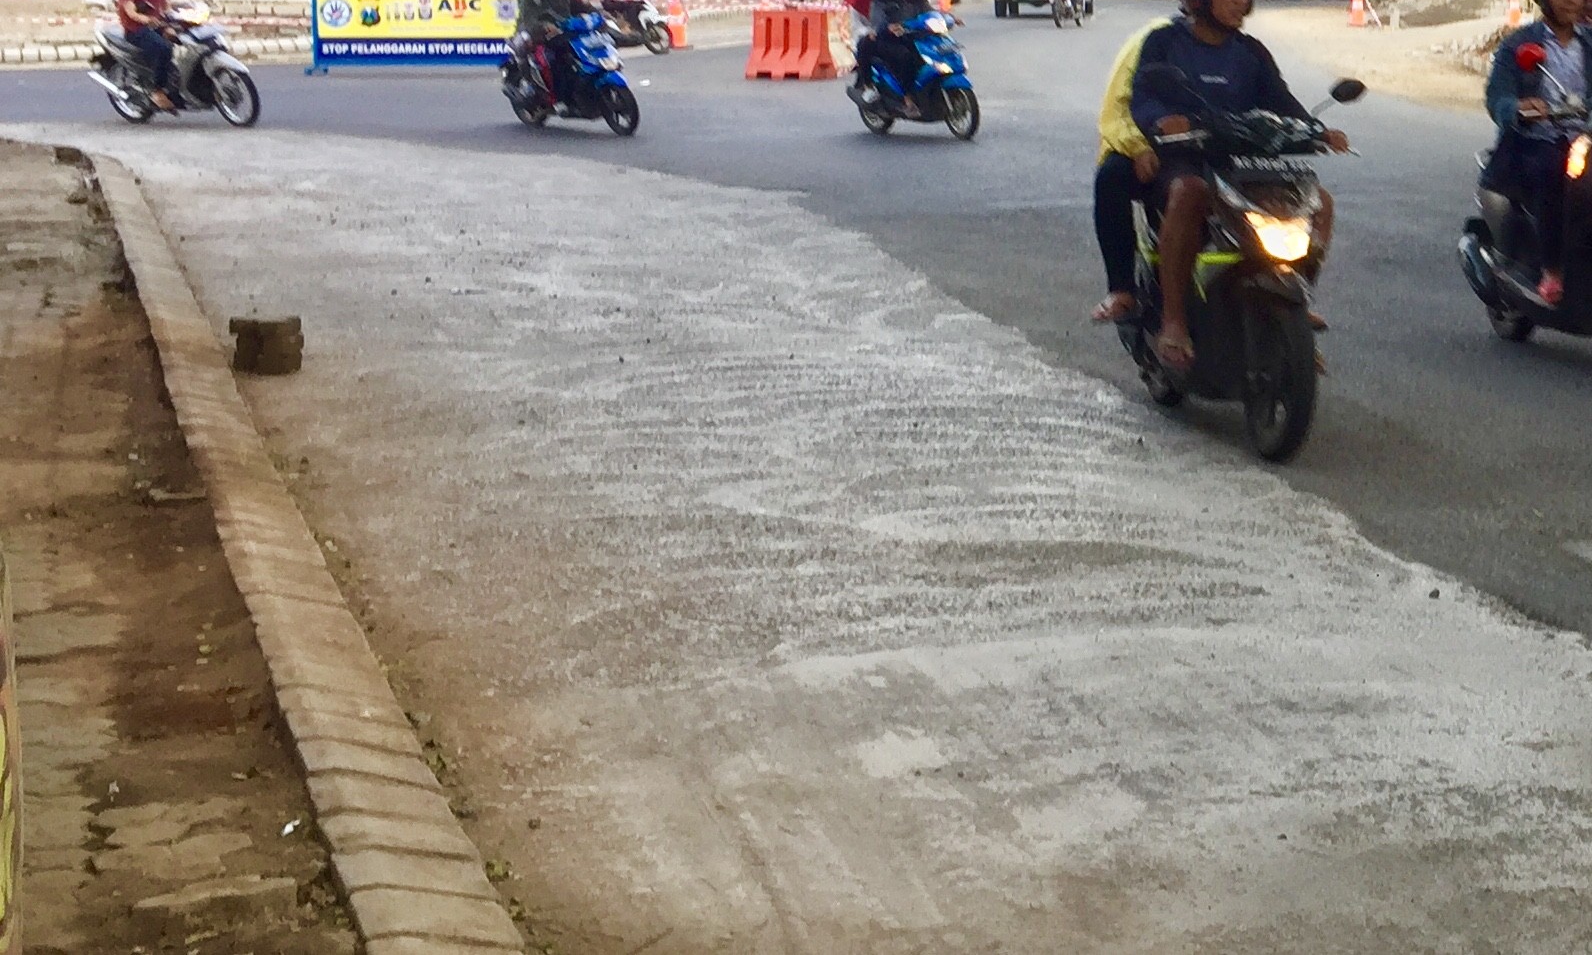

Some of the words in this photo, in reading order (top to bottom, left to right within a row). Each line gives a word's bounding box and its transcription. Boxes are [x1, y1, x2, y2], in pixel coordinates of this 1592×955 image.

[322, 43, 348, 54] STOP
[351, 43, 426, 54] PELANGGARAN
[428, 43, 454, 54] STOP
